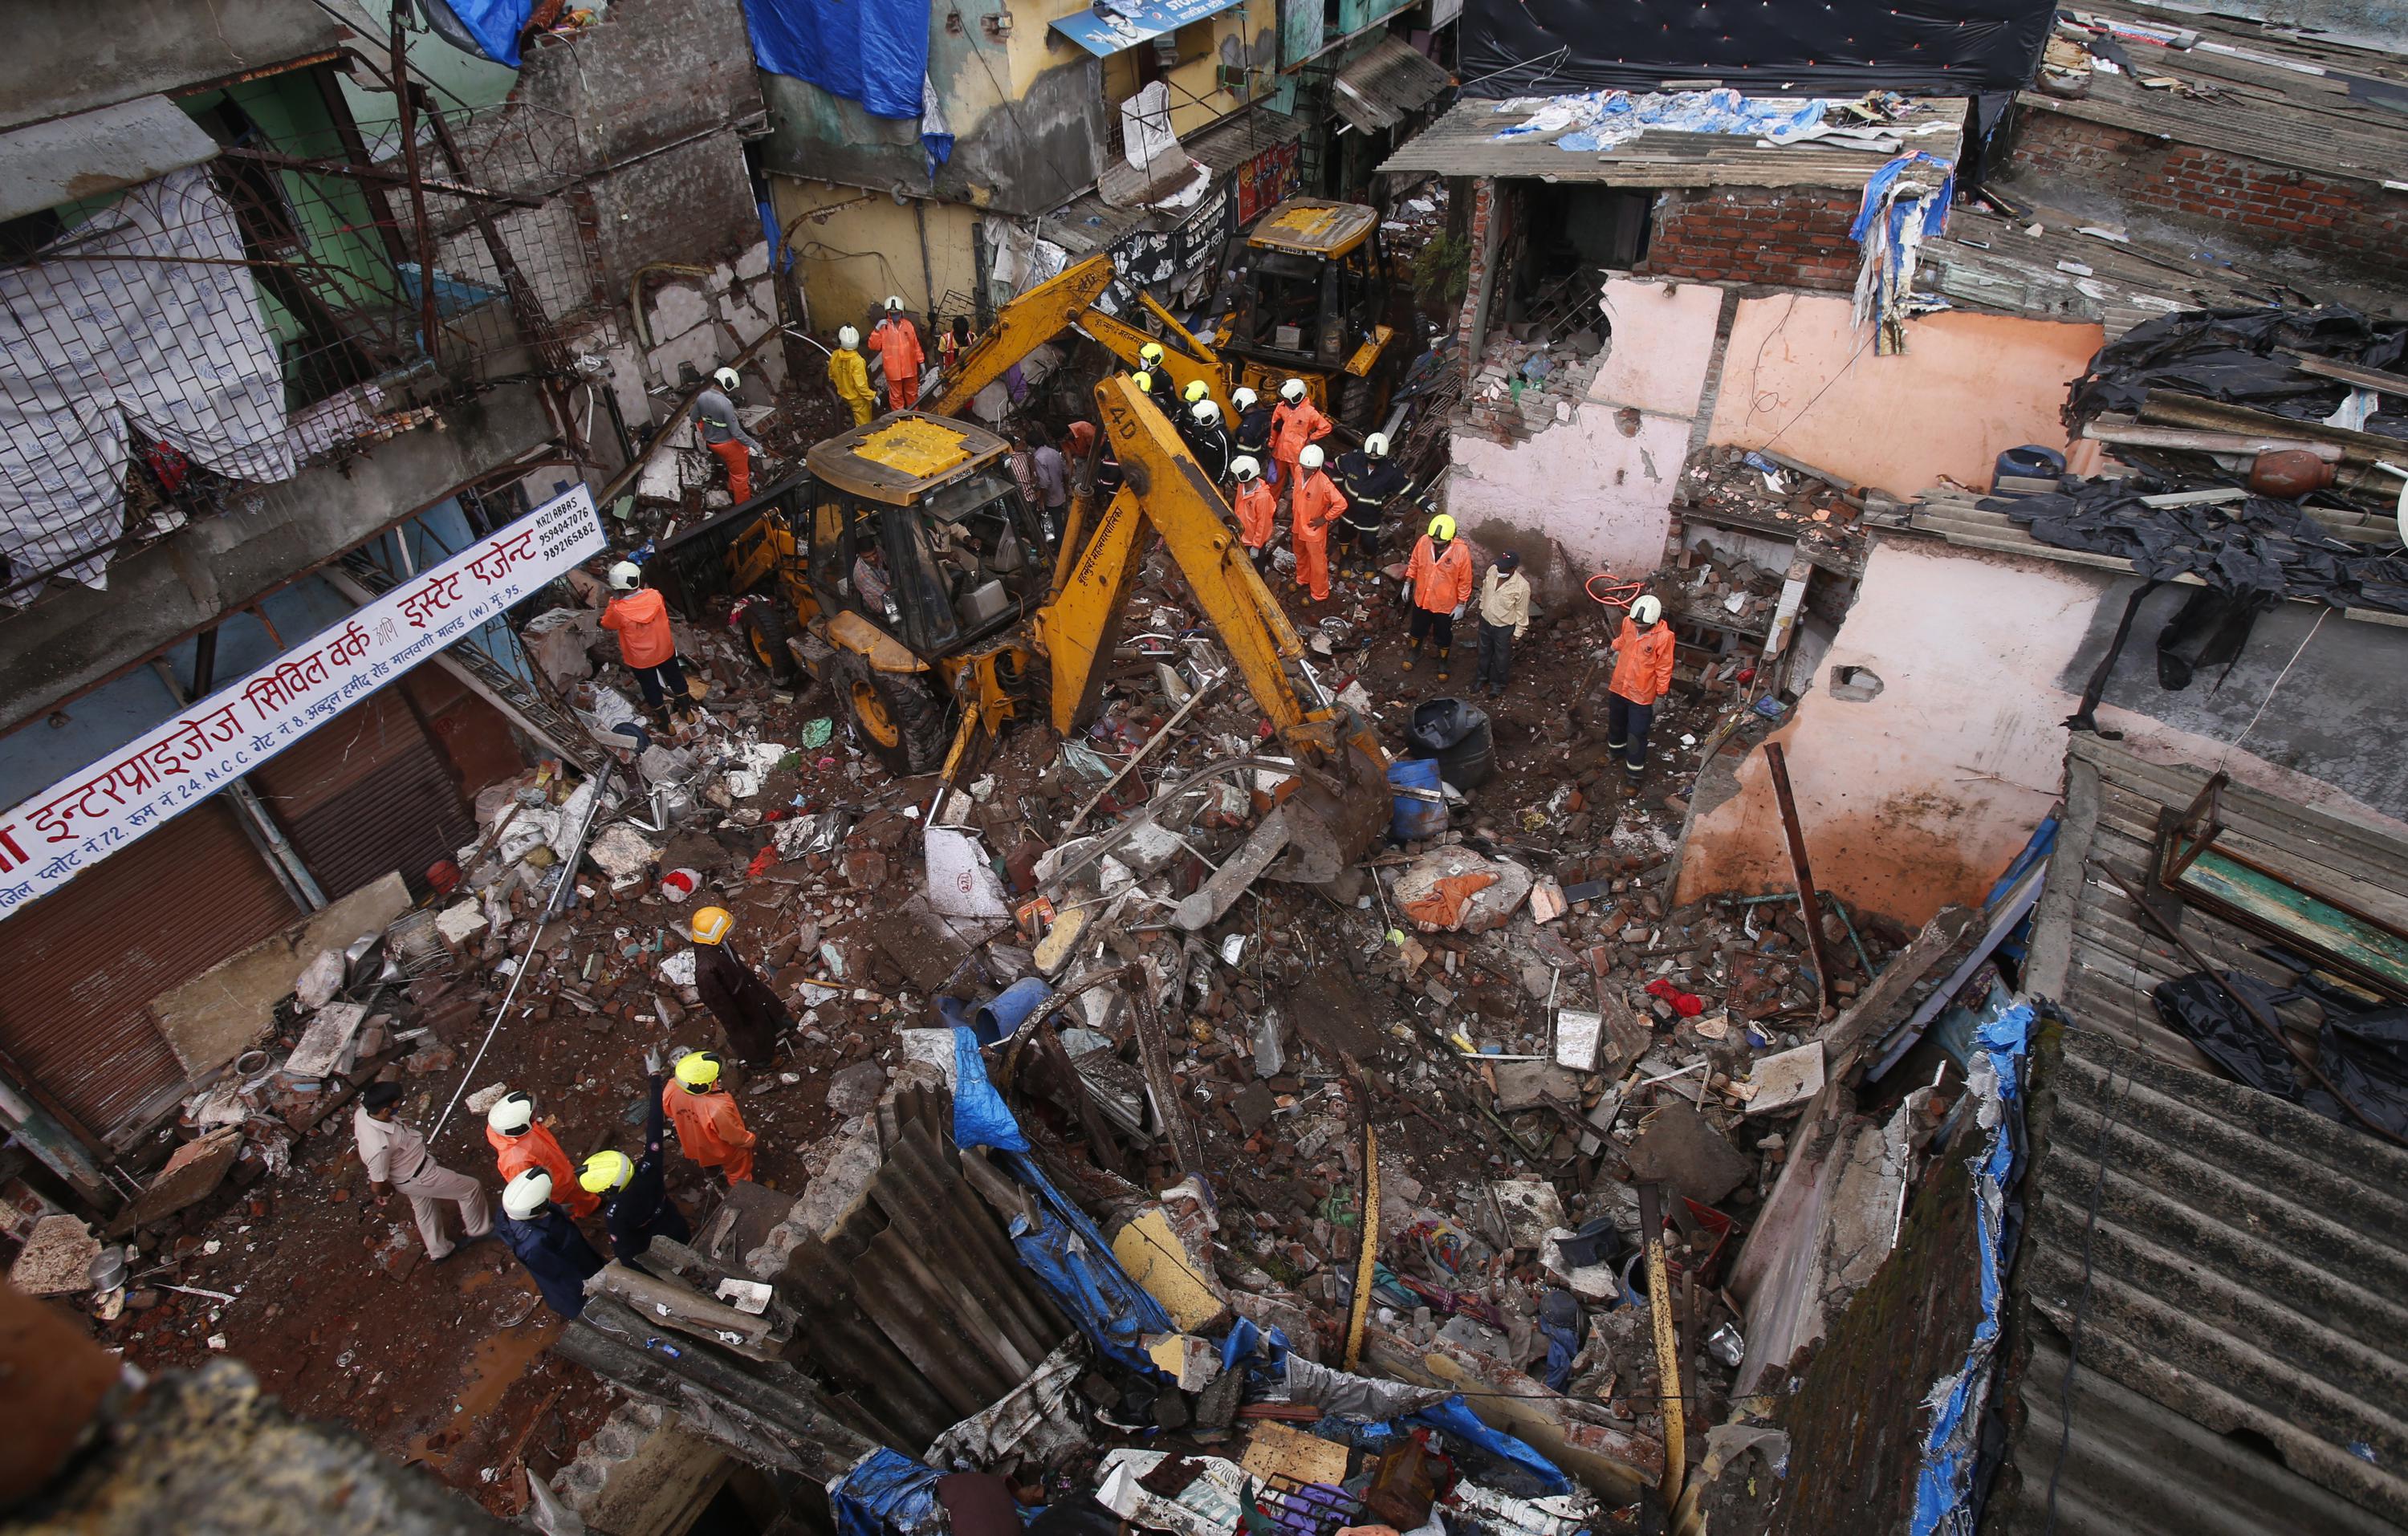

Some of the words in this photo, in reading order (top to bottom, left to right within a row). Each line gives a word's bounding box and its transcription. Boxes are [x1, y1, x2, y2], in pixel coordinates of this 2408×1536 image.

[535, 511, 554, 529] KAZI
[552, 497, 577, 519] ABBAS
[539, 506, 589, 547] 9594047076
[1092, 506, 1123, 560] महानगरपालिका
[543, 522, 596, 562] 9892165882
[26, 702, 244, 843] इन्टरप्राइजेज
[241, 650, 329, 720] सिविल
[326, 620, 370, 666] वर्क
[397, 571, 463, 628] इस्टेट
[464, 528, 536, 586] एजेन्ट
[0, 880, 35, 908] जिल
[125, 803, 159, 827] रूम
[341, 674, 373, 698] हमीद
[370, 661, 389, 678] रोड
[389, 632, 435, 664] मालवणी
[435, 616, 466, 638] मालड
